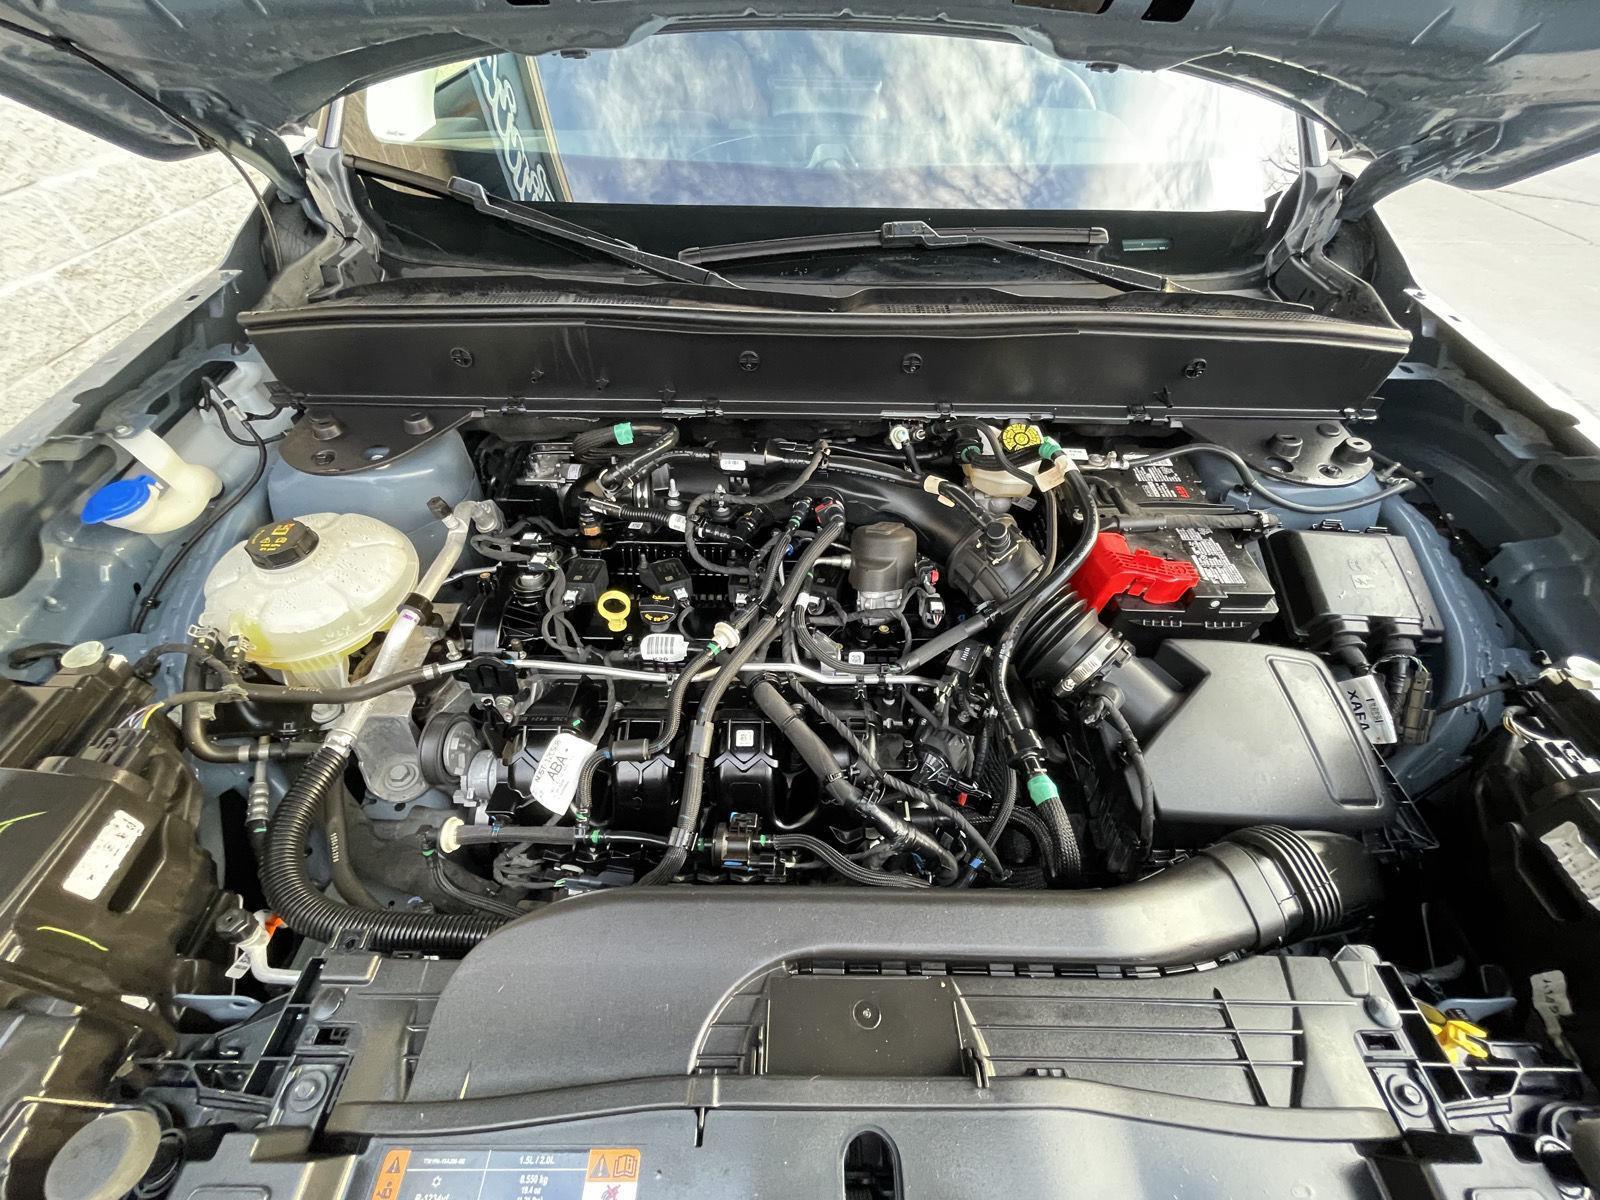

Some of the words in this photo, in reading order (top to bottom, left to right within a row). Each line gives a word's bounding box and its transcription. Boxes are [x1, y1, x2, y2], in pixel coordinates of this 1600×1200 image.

[547, 756, 568, 781] ABA
[520, 1155, 534, 1165] 1.5L
[540, 1155, 555, 1165] 2.0L
